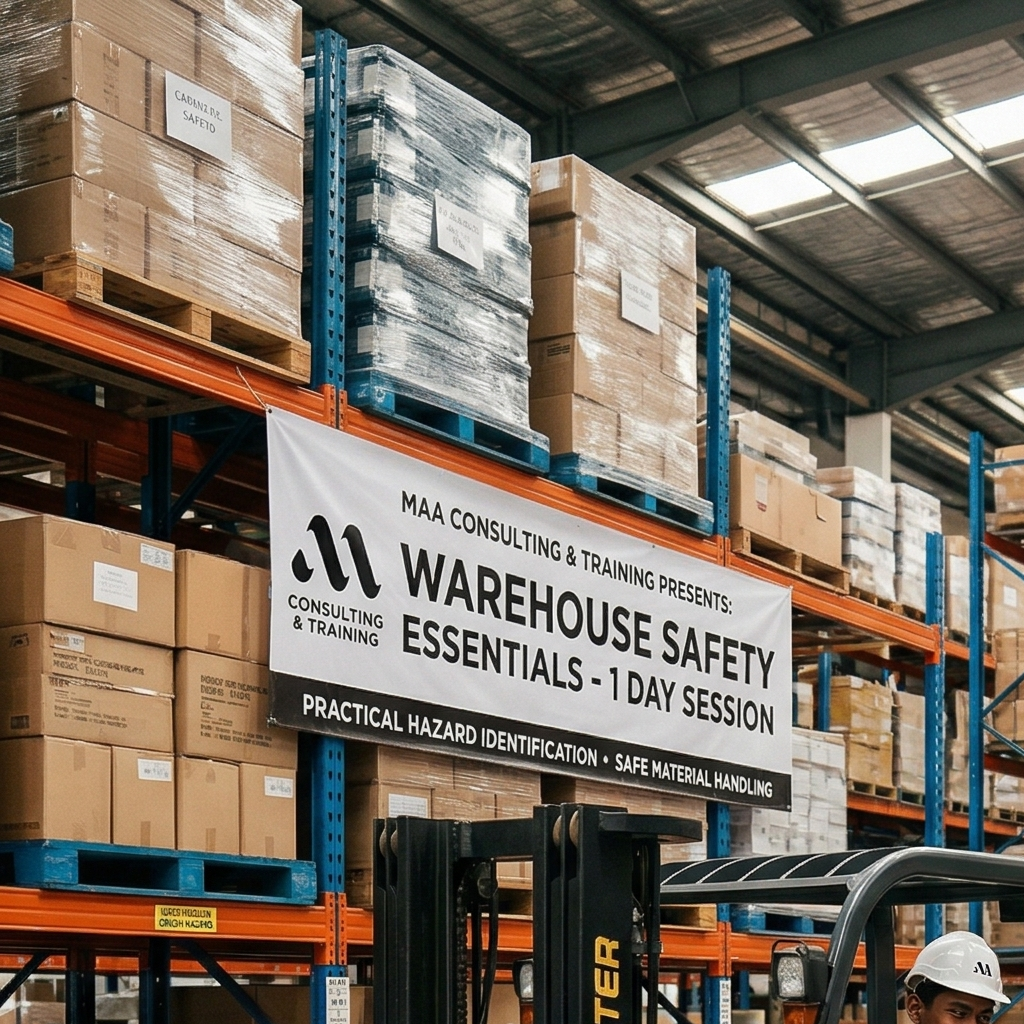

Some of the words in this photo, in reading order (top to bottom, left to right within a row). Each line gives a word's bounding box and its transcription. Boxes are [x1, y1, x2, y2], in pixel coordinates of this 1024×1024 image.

[401, 490, 445, 525] MAA
[450, 507, 561, 562] CONSULTING
[566, 545, 577, 567] &
[581, 549, 655, 591] TRAINING
[659, 574, 733, 615] PRESENTS:
[288, 594, 384, 629] CONSULTING
[293, 615, 303, 630] &
[307, 618, 379, 647] TRAINING
[400, 542, 652, 660] WAREHOUSE
[662, 620, 775, 689] SAFETY
[402, 614, 583, 692] ESSENTIALS
[609, 667, 618, 701] 1
[627, 670, 676, 713] DAY
[682, 685, 774, 735] SESSION
[303, 694, 404, 732] PRACTICAL
[408, 713, 477, 745] HAZARD
[481, 727, 598, 767] IDENTIFICATION
[615, 753, 649, 776] SAFE
[652, 760, 712, 788] MATERIAL
[714, 771, 773, 798] HANDLING
